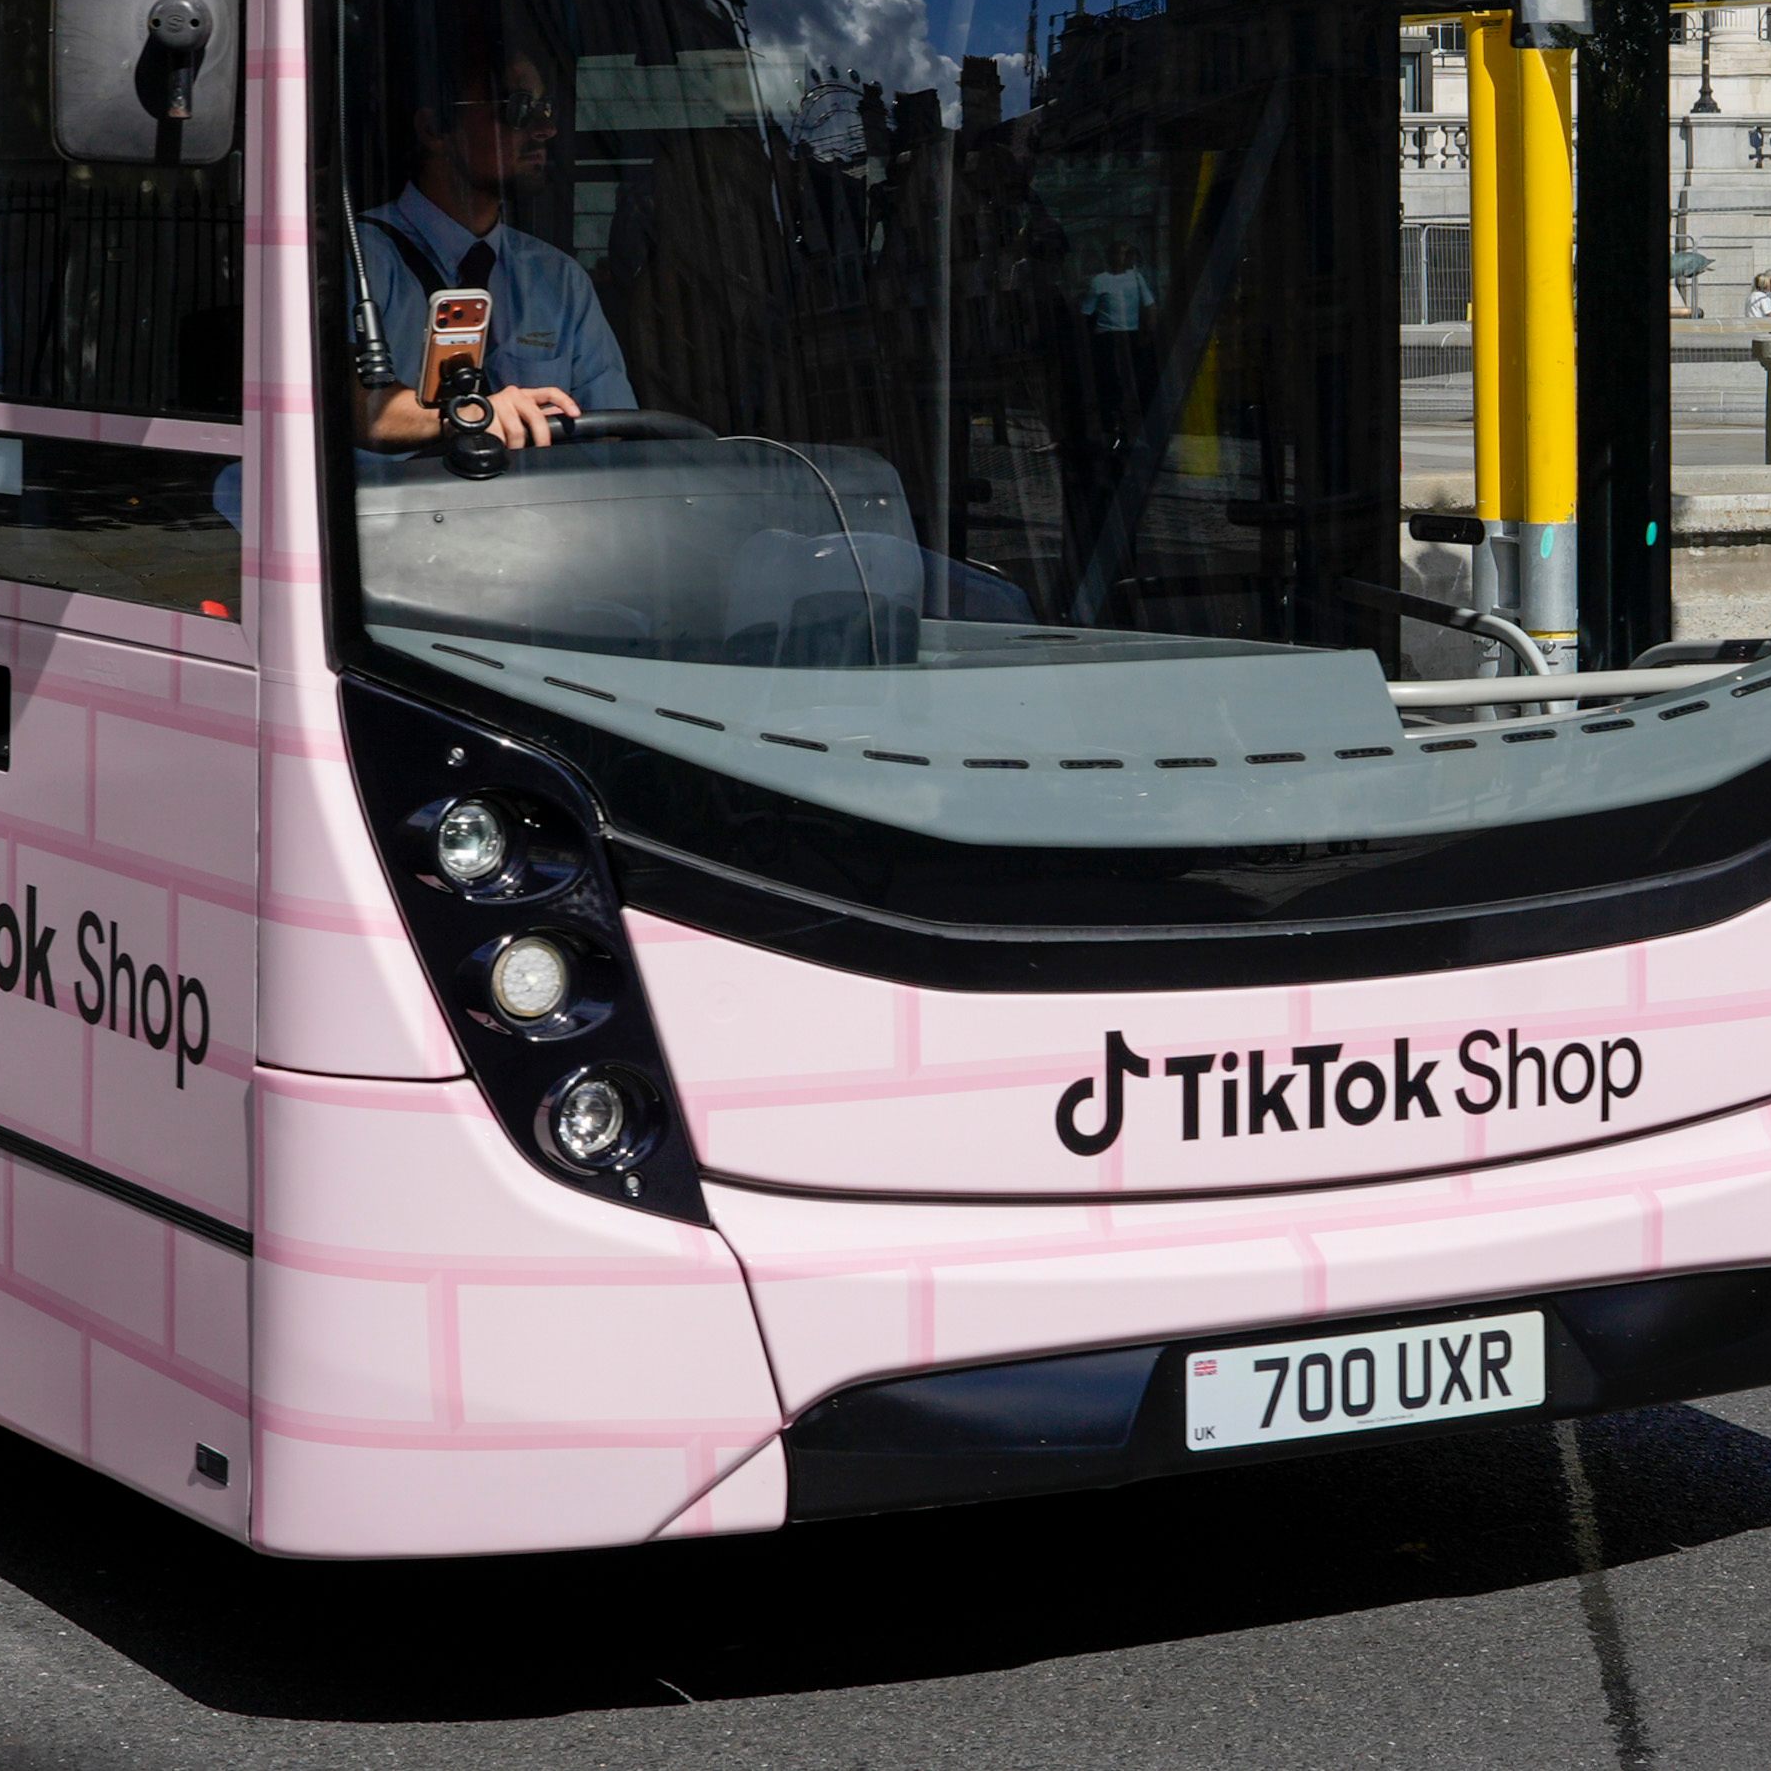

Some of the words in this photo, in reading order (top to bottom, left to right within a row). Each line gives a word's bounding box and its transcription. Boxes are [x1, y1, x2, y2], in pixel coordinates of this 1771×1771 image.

[73, 909, 210, 1090] Shop
[1164, 1036, 1442, 1142] TikTok
[1454, 1027, 1643, 1122] Shop
[1251, 1346, 1375, 1429] 700
[1397, 1328, 1512, 1410] UXR
[1193, 1425, 1217, 1443] UK
